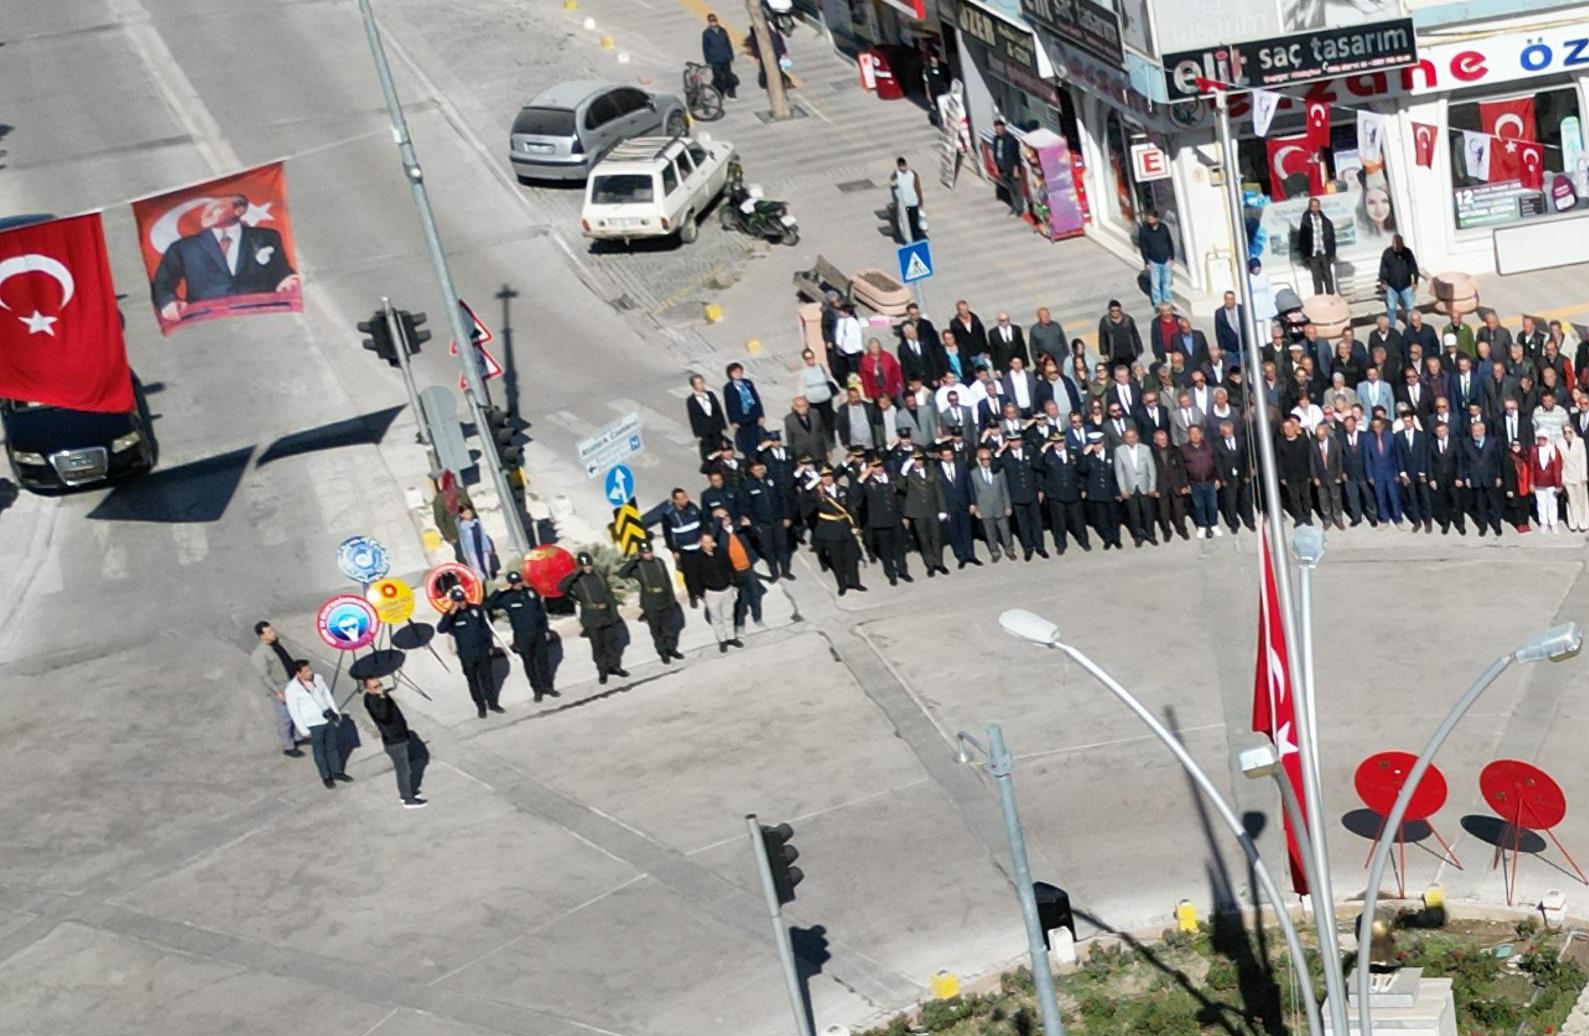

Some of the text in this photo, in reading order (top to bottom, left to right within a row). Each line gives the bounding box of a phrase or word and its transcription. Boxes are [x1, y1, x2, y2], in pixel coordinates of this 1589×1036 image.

[1173, 48, 1250, 95] elit
[1258, 43, 1303, 71] saç
[1310, 26, 1409, 62] tasarım
[1142, 150, 1162, 174] E
[1455, 190, 1473, 205] 12
